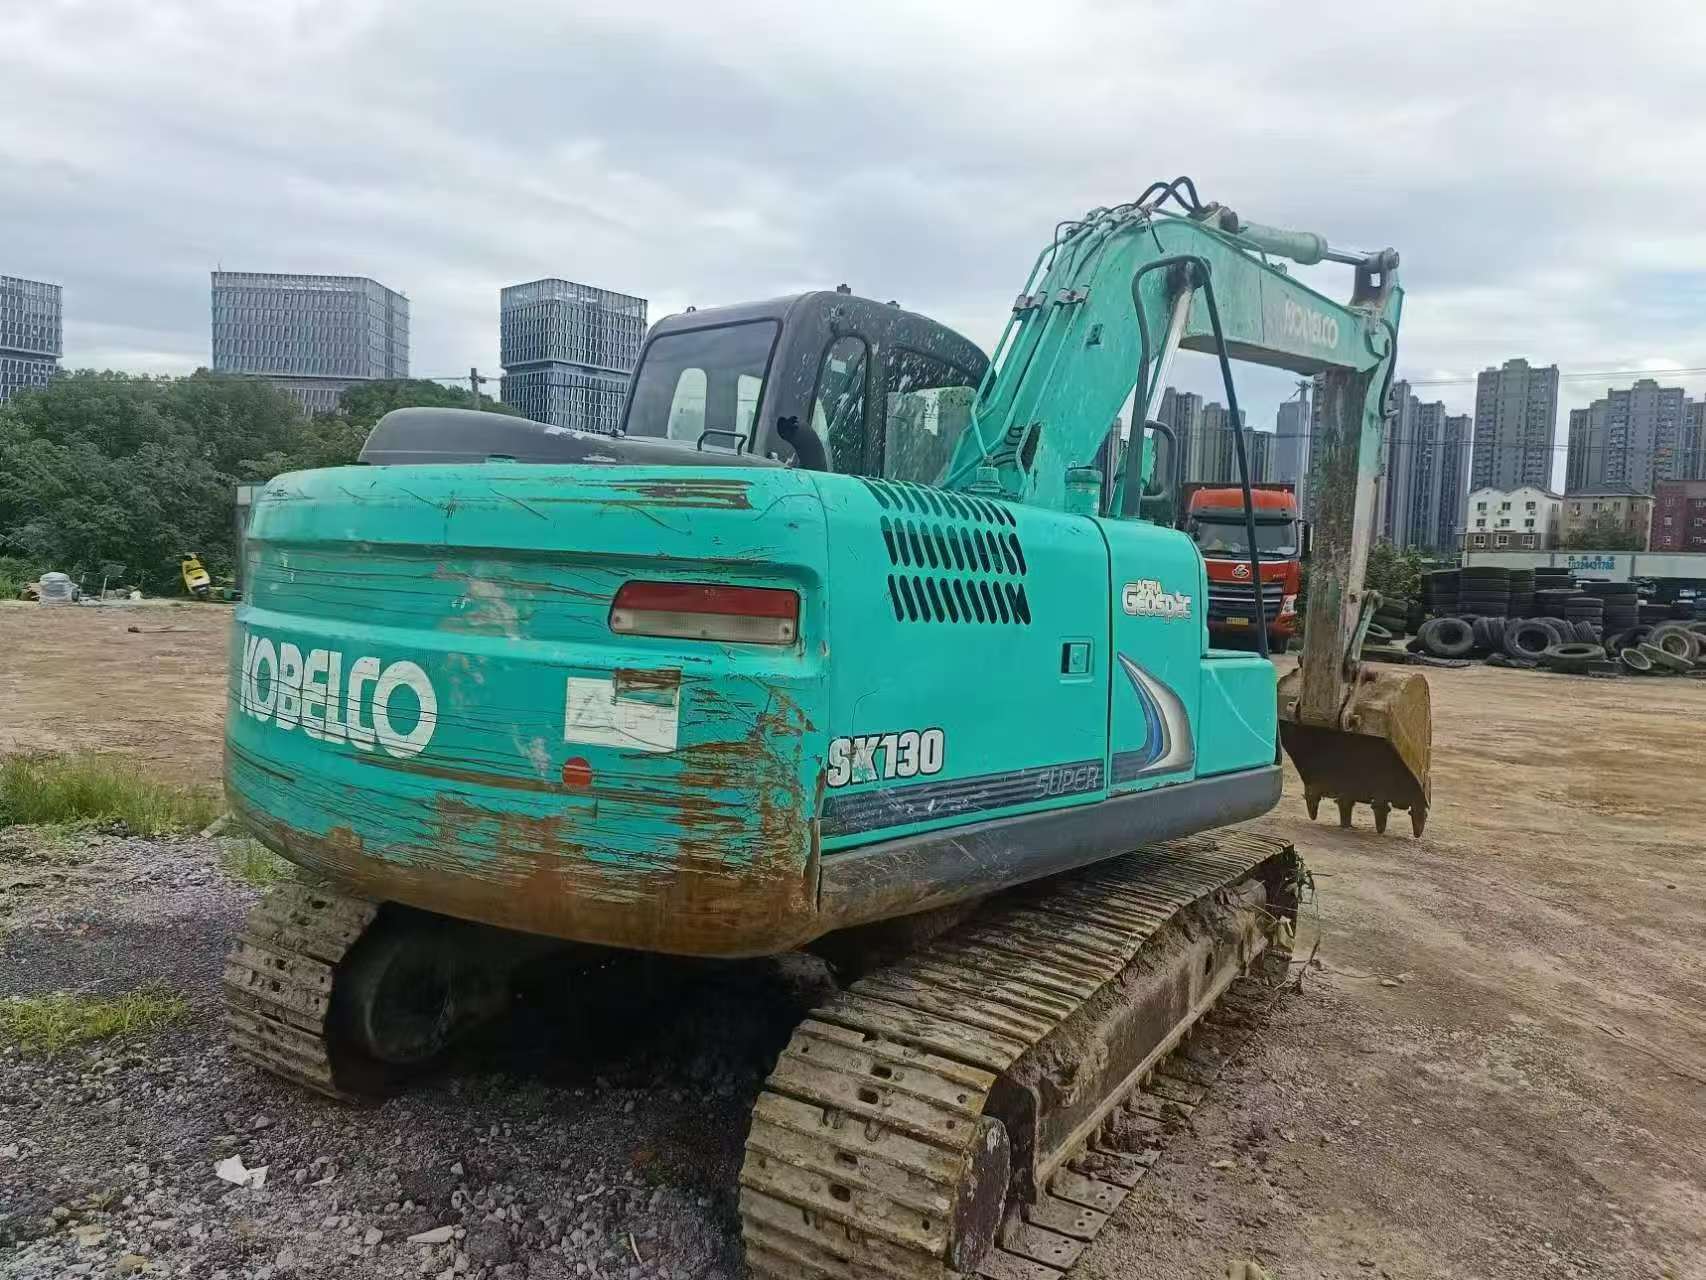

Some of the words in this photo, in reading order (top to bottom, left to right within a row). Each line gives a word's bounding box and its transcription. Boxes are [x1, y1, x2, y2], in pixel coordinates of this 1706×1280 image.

[240, 632, 438, 759] KOBELCO
[826, 726, 945, 788] SK130
[1033, 765, 1099, 799] SUPER
